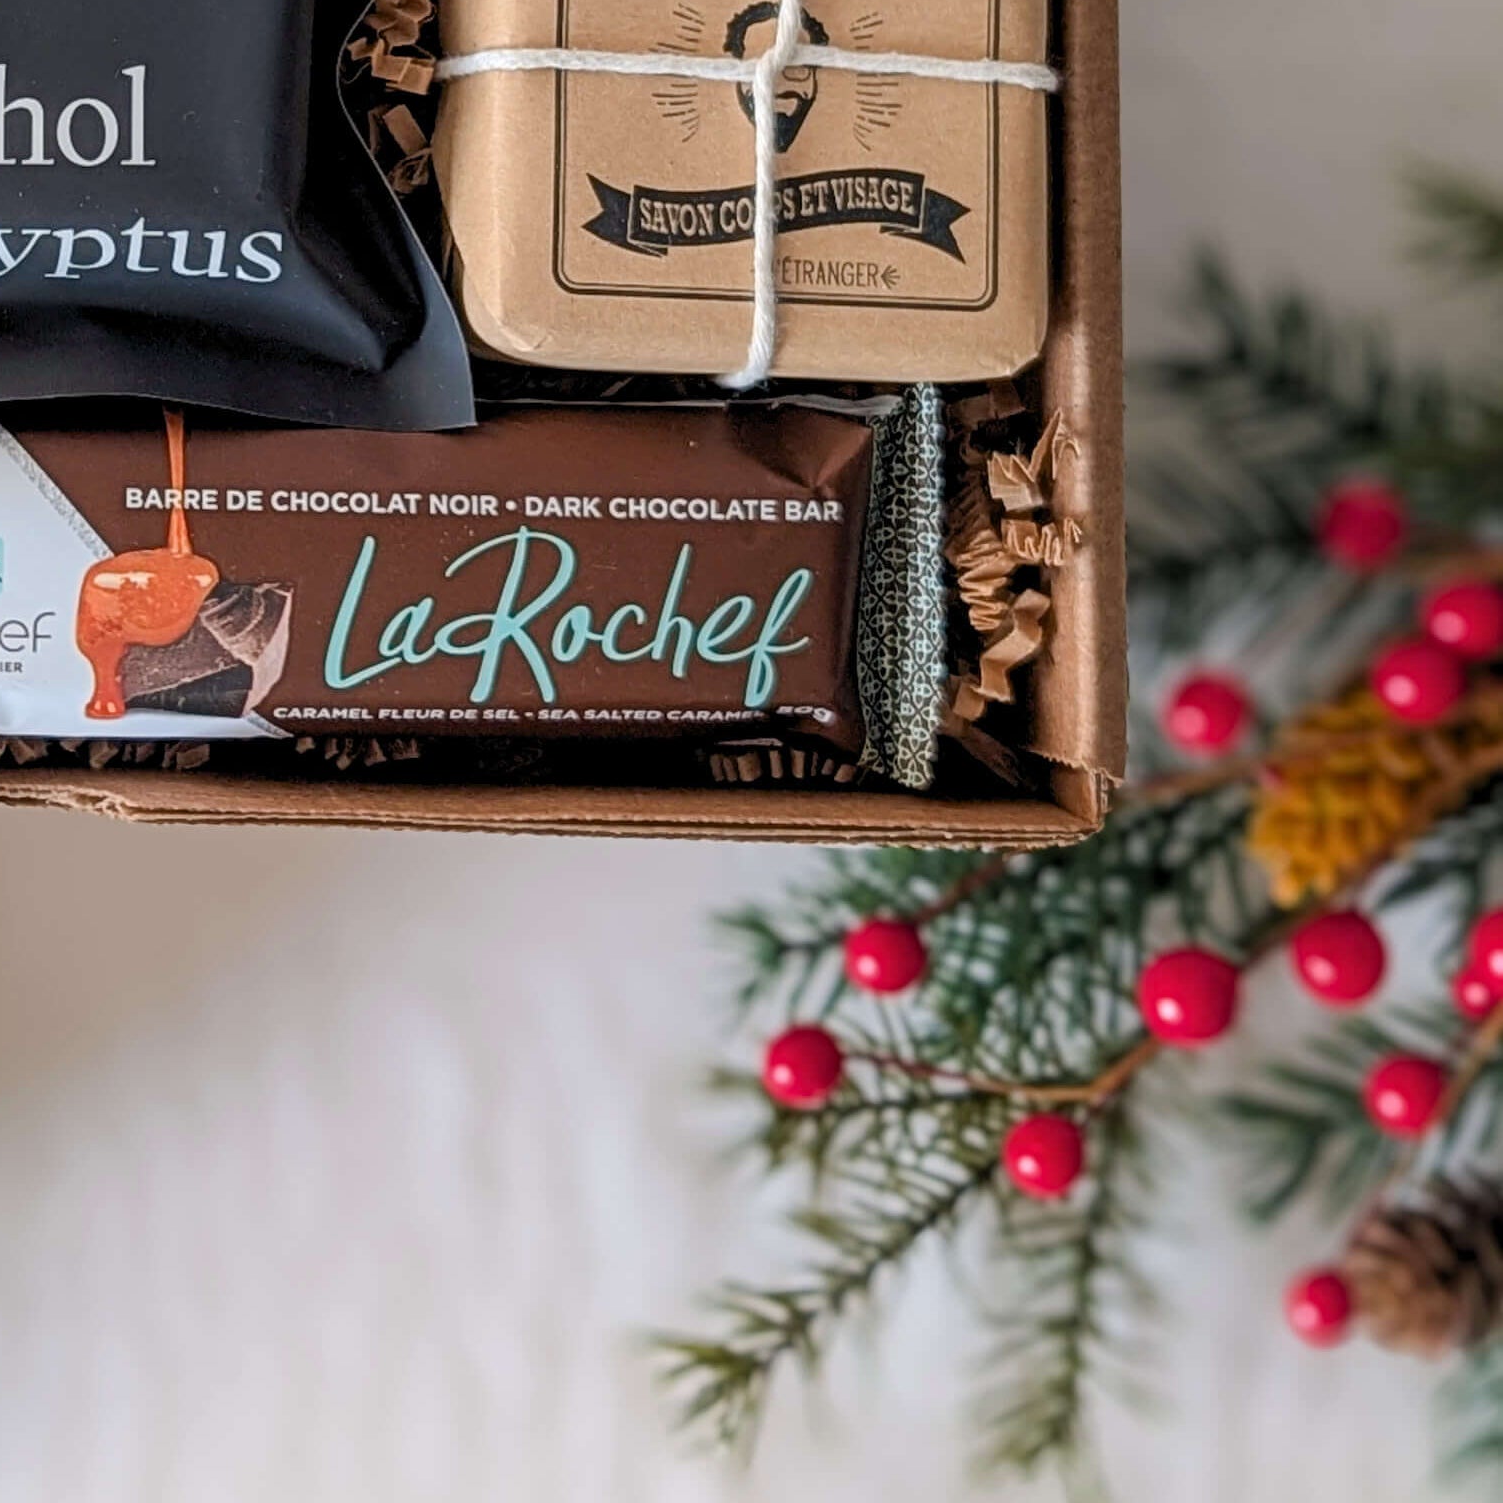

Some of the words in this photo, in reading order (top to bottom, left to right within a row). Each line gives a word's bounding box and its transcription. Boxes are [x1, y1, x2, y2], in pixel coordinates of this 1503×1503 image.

[639, 198, 715, 237] SAVON
[719, 187, 795, 234] COPS
[800, 182, 829, 217] ET
[830, 177, 916, 216] VISAGE
[125, 487, 218, 511] BARRE
[226, 490, 264, 512] DE
[271, 491, 422, 515] CHOCOLAT
[429, 494, 498, 517] NOIR
[524, 495, 602, 518] DARK
[609, 497, 778, 521] CHOCOLATE
[785, 499, 843, 522] BAR
[272, 707, 373, 720] CARAMEL
[378, 708, 445, 720] FLEUR
[449, 708, 477, 720] DE
[482, 708, 519, 720] SEL
[537, 708, 580, 721] SEA
[583, 709, 662, 721] SALTED
